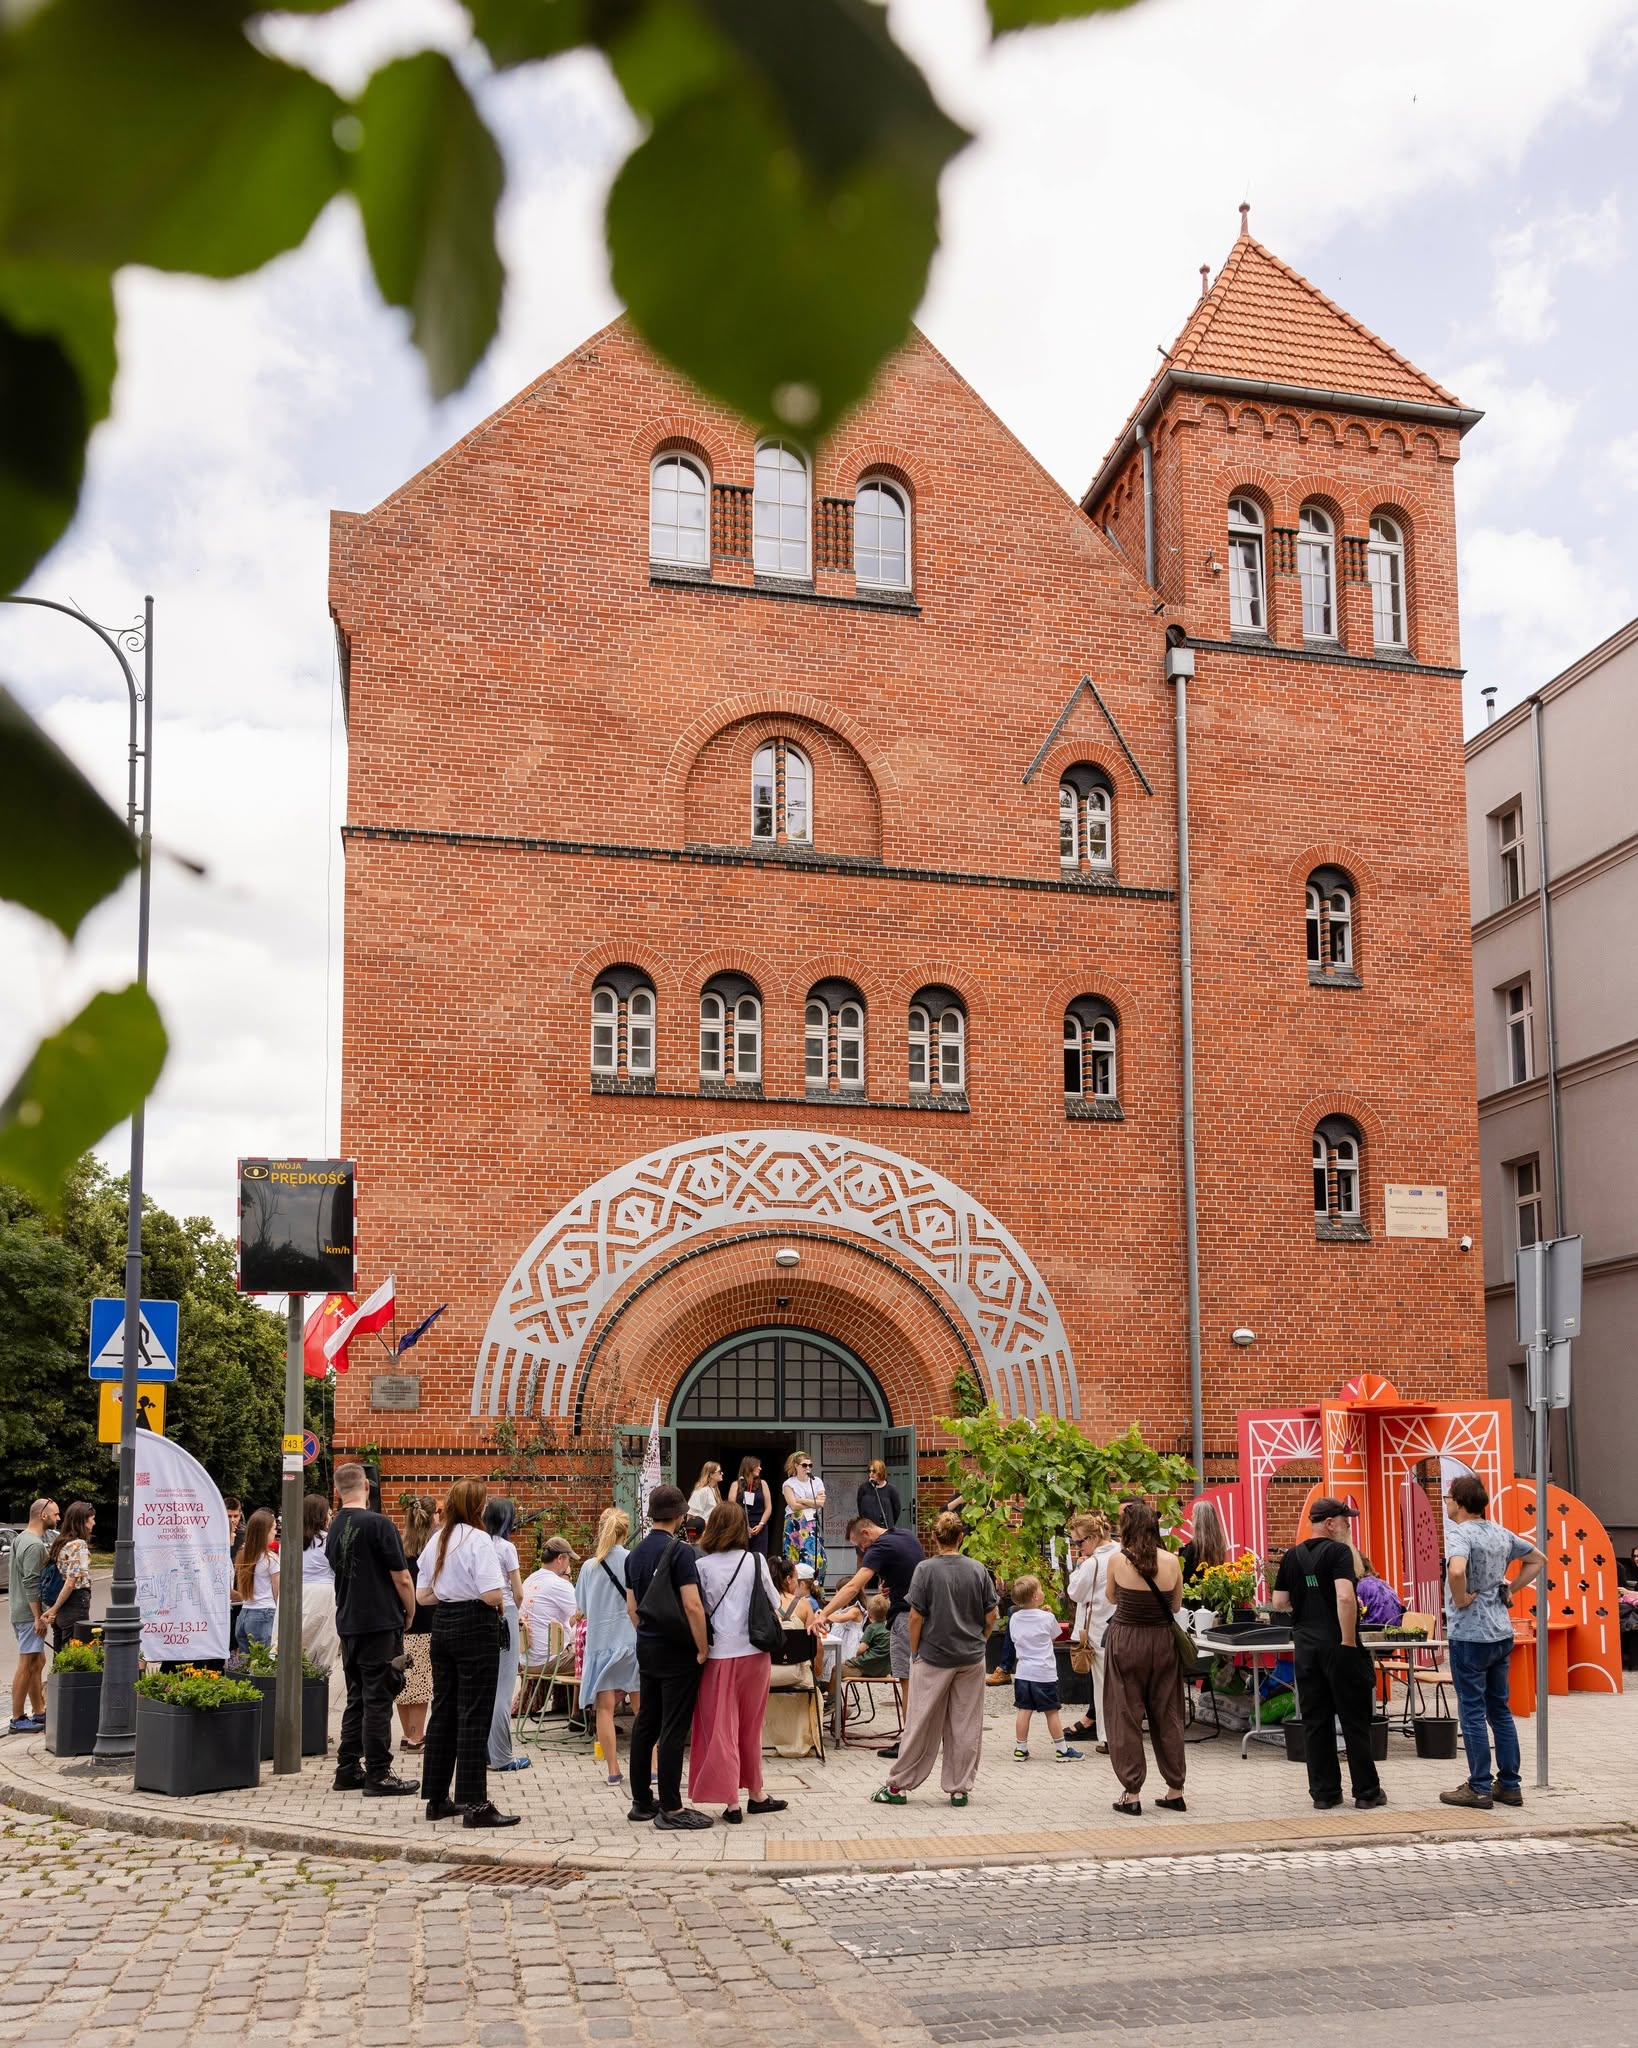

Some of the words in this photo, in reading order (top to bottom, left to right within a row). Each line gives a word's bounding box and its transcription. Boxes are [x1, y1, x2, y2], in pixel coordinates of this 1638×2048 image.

[272, 1162, 302, 1170] TWOJA
[271, 1171, 346, 1187] PRĘDKOŚĆ
[325, 1246, 350, 1254] km/h
[144, 1501, 204, 1515] wystawa
[137, 1513, 155, 1526] do
[158, 1514, 210, 1528] zabawy
[163, 1634, 189, 1644] 2026
